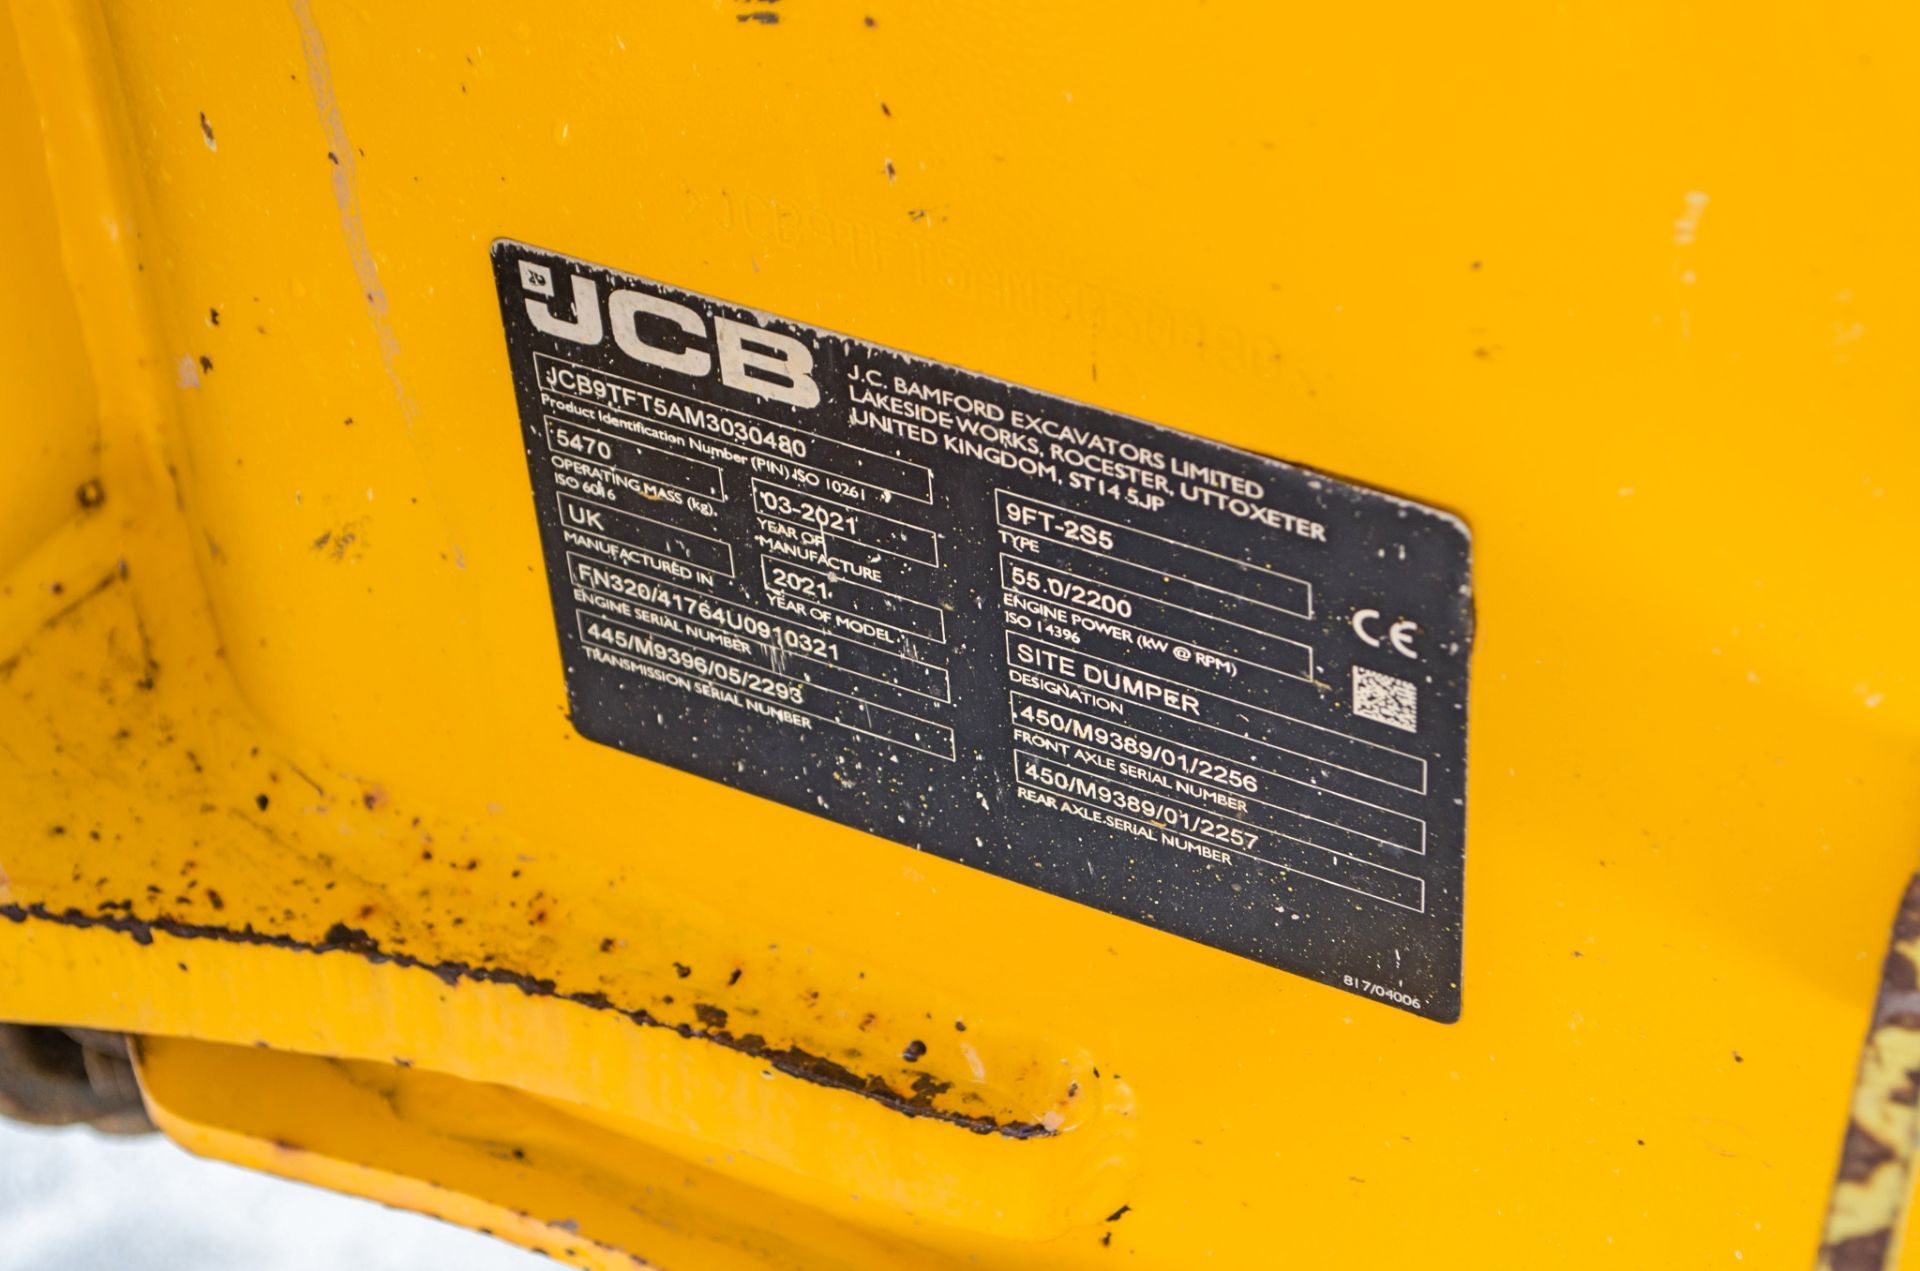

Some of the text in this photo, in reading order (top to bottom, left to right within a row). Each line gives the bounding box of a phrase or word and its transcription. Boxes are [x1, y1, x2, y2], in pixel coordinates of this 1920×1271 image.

[518, 260, 820, 409] JCB
[547, 367, 806, 457] JCB9TFT5AM3030480
[557, 429, 611, 459] 5470
[848, 365, 1263, 499] J.C. BAMFORD EXCAVATORS LIMITED
[541, 393, 595, 419] Product
[598, 410, 685, 446] Identification
[689, 438, 748, 464] Number
[794, 469, 819, 486] ISO
[826, 479, 865, 501] 10261
[551, 456, 641, 494] OPERATING
[644, 483, 682, 504] MASS
[850, 386, 1326, 541] LAKESIDE WORKS, ROCESTER, UTTOXETER
[852, 407, 1164, 511] UNITED KINGDOM, ST14 5JP
[555, 472, 616, 500] ISO 6016
[569, 504, 604, 530] UK
[564, 531, 713, 586] MANUFACTURED IN
[757, 517, 825, 550] YEAR OF
[758, 535, 882, 583] MANUFACTURE
[998, 530, 1039, 553] TYPE
[1007, 503, 1113, 549] 9FT-2S5
[574, 589, 751, 655] ENGINE SERIAL NUMBER
[579, 564, 838, 660] FN320/41764U0910321
[767, 593, 807, 616] YEAR
[811, 608, 831, 622] OF
[1012, 567, 1131, 617] 55.0/2200
[1004, 593, 1237, 677] ENGINE POWER (kW @ RPM)
[1005, 611, 1080, 644] ISO 14396
[1352, 608, 1417, 658] CE
[582, 646, 812, 729] TRANSMISSION SERIAL NUMBER
[588, 624, 803, 704] 445/M9396/05/2293
[1009, 670, 1123, 715] DESIGNATION
[1018, 644, 1199, 715] SITE DUMPER
[1014, 729, 1248, 813] FRONT AXLE SERIAL NUMBER
[1020, 702, 1257, 792] 450/M9389/01/2256
[1018, 787, 1232, 865] REAR AXLE SERIAL NUMBER
[1025, 762, 1259, 852] 450/M9389/01/2257
[1344, 975, 1420, 1009] 817/04006
